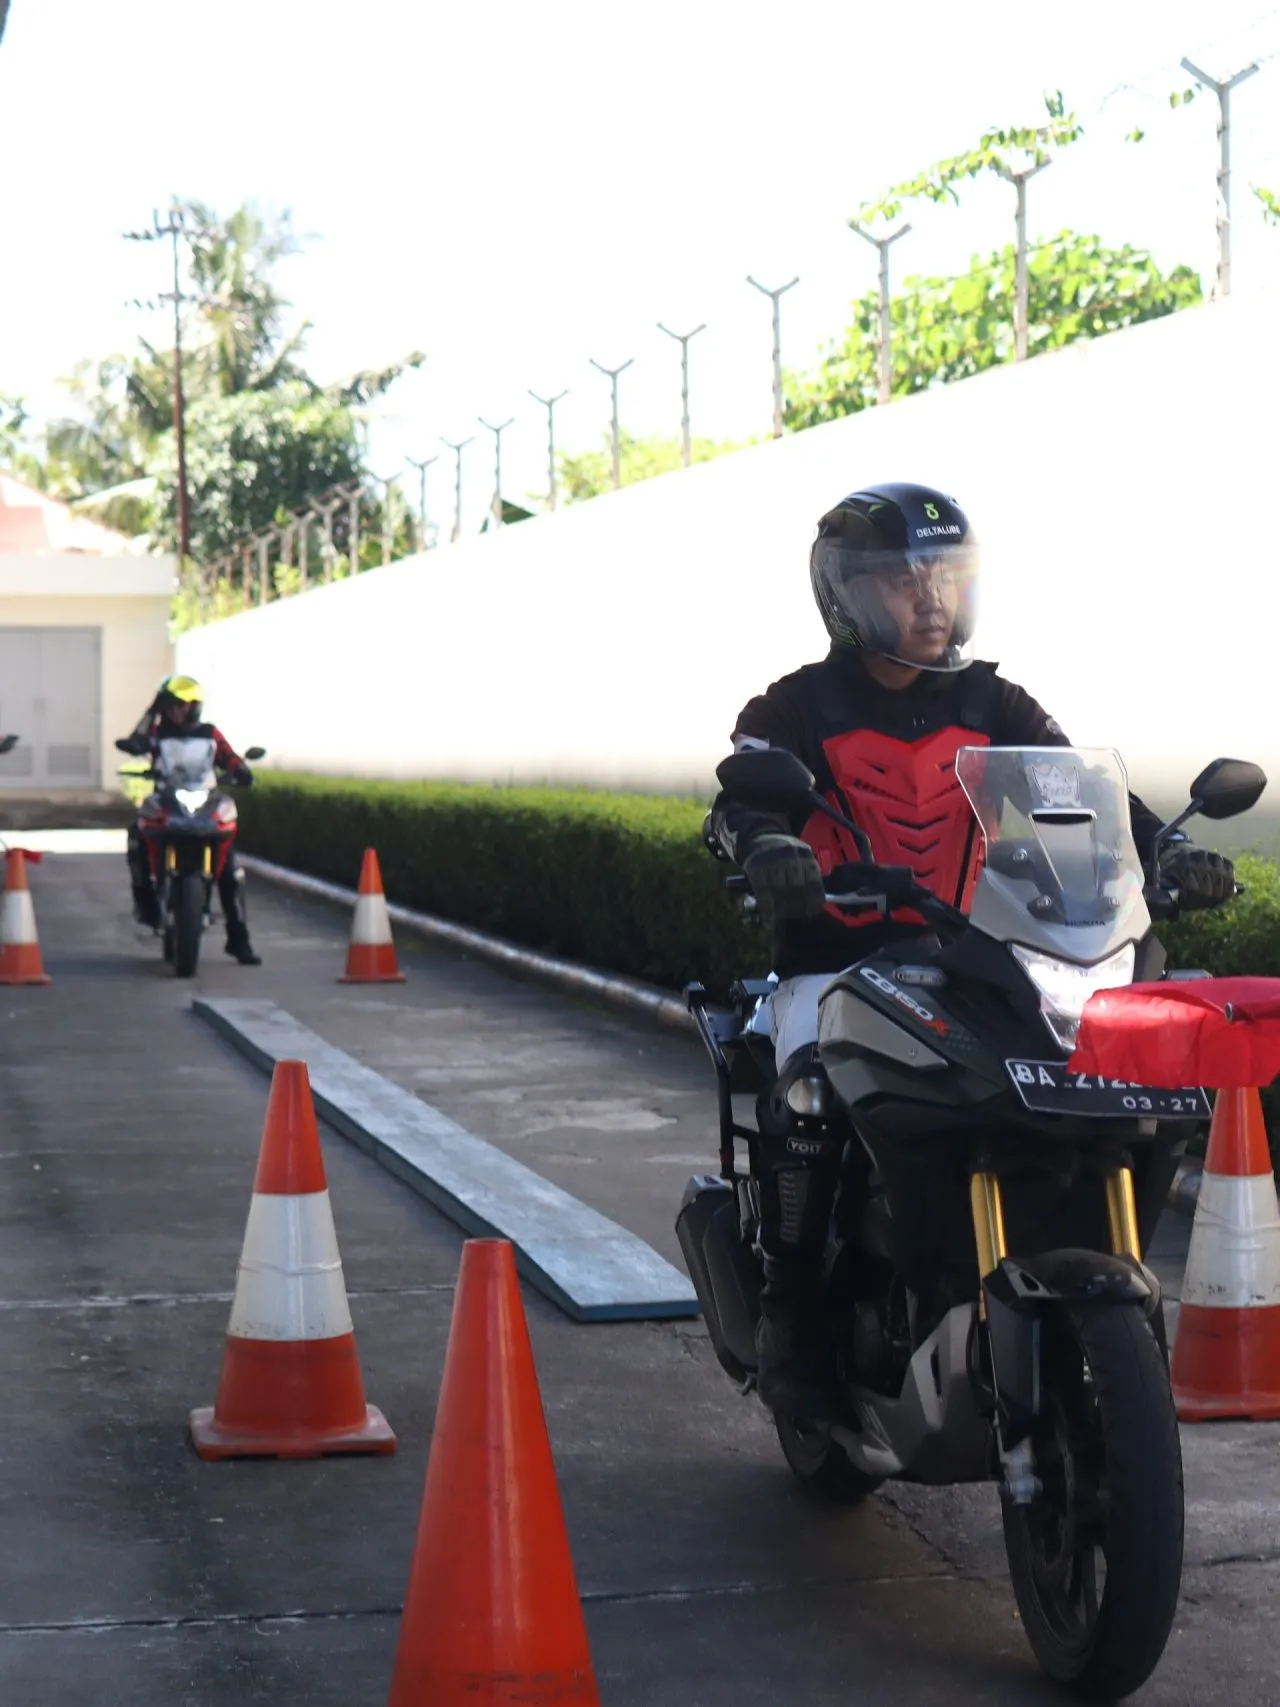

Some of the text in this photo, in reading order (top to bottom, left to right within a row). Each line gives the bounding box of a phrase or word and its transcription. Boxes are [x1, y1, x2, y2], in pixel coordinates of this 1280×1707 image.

[915, 524, 961, 538] DELTALUBE
[1064, 919, 1106, 928] HONDA
[1014, 1063, 1056, 1087] BA
[790, 1140, 821, 1154] VOLT
